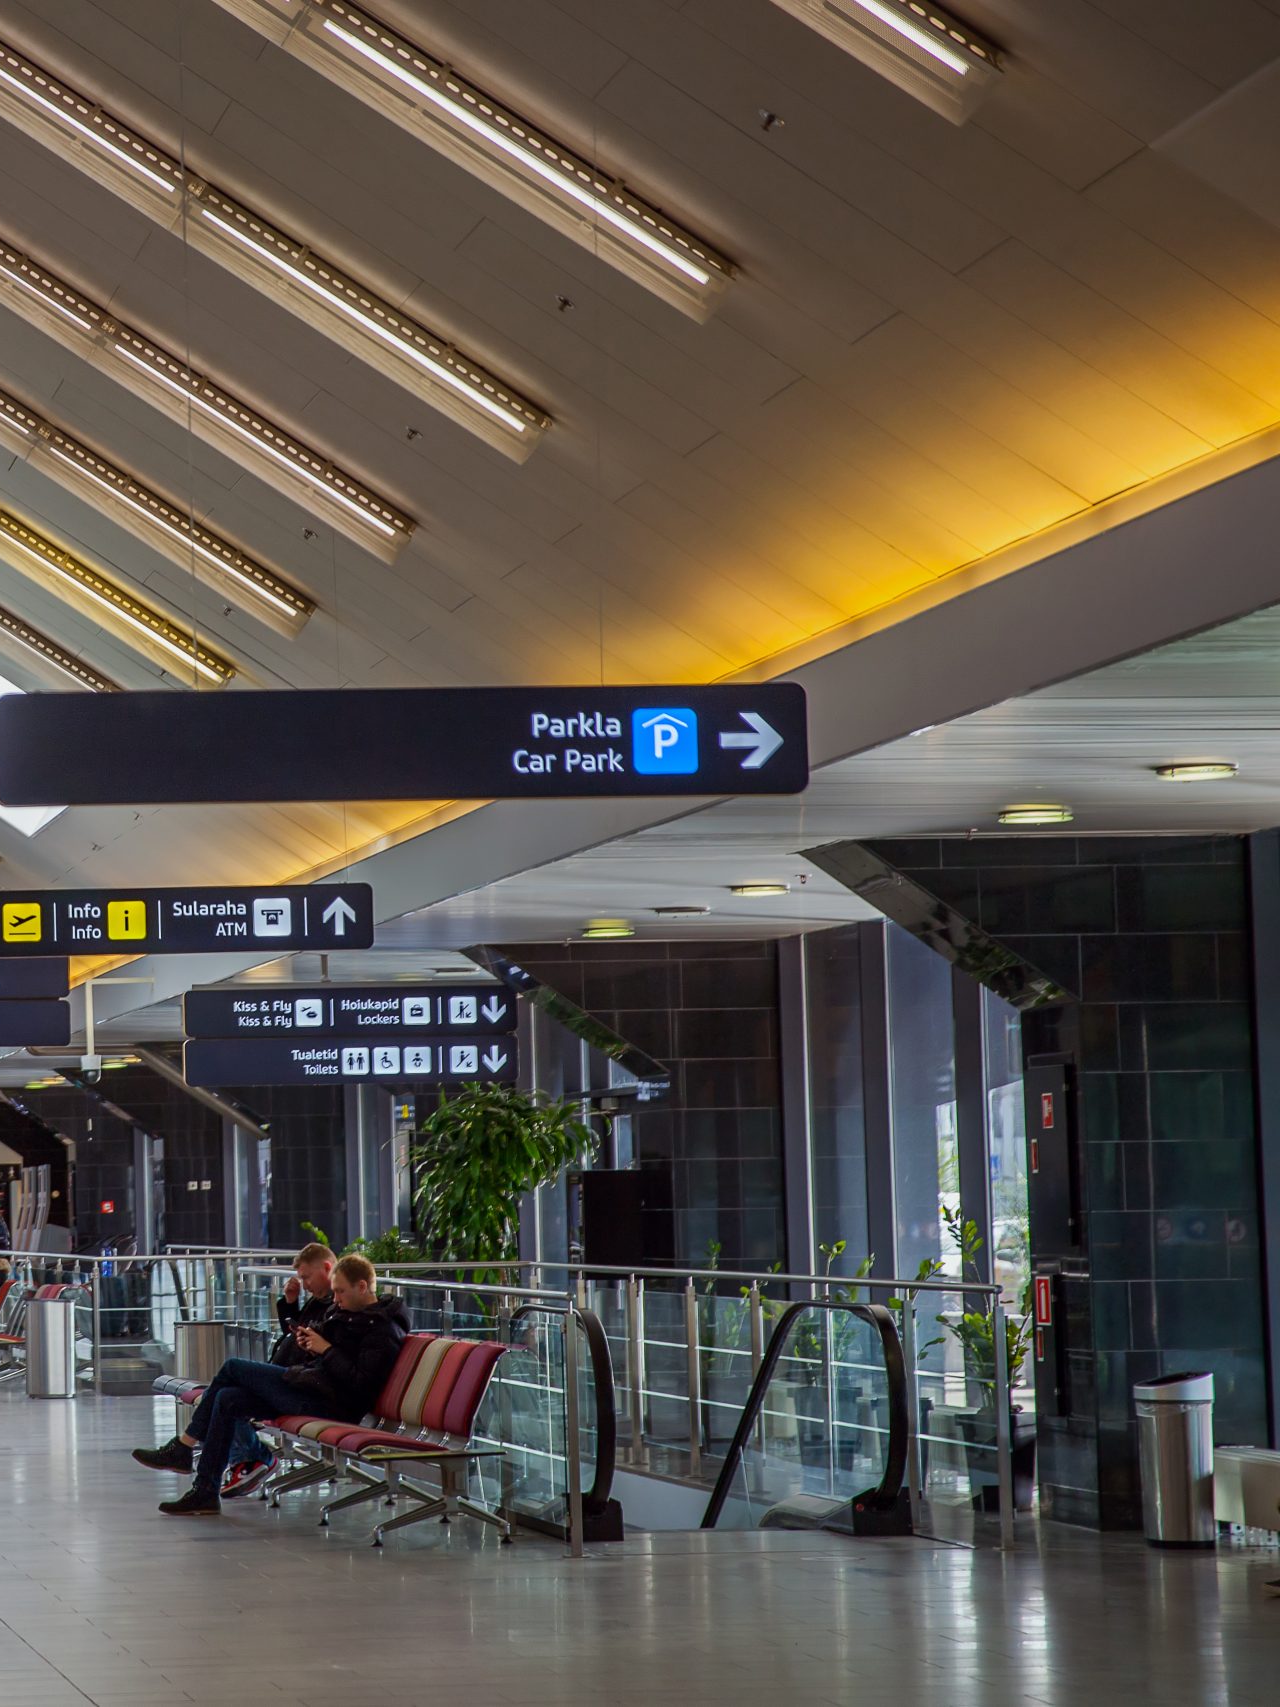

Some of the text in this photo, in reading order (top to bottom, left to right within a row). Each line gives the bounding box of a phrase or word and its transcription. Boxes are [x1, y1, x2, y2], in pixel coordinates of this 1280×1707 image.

[532, 712, 621, 737] Parkla
[514, 748, 624, 773] Car Park
[69, 903, 100, 918] Info
[173, 900, 246, 916] Sularaha
[73, 925, 101, 939] Info
[216, 922, 246, 936] ATM
[234, 1000, 291, 1013] Kiss & Fly
[341, 998, 399, 1012] Hoiukapid
[239, 1015, 293, 1029] Kiss & Fly
[358, 1014, 399, 1024] Lockers
[291, 1049, 337, 1060] Tualetid
[303, 1064, 338, 1074] Toilets
